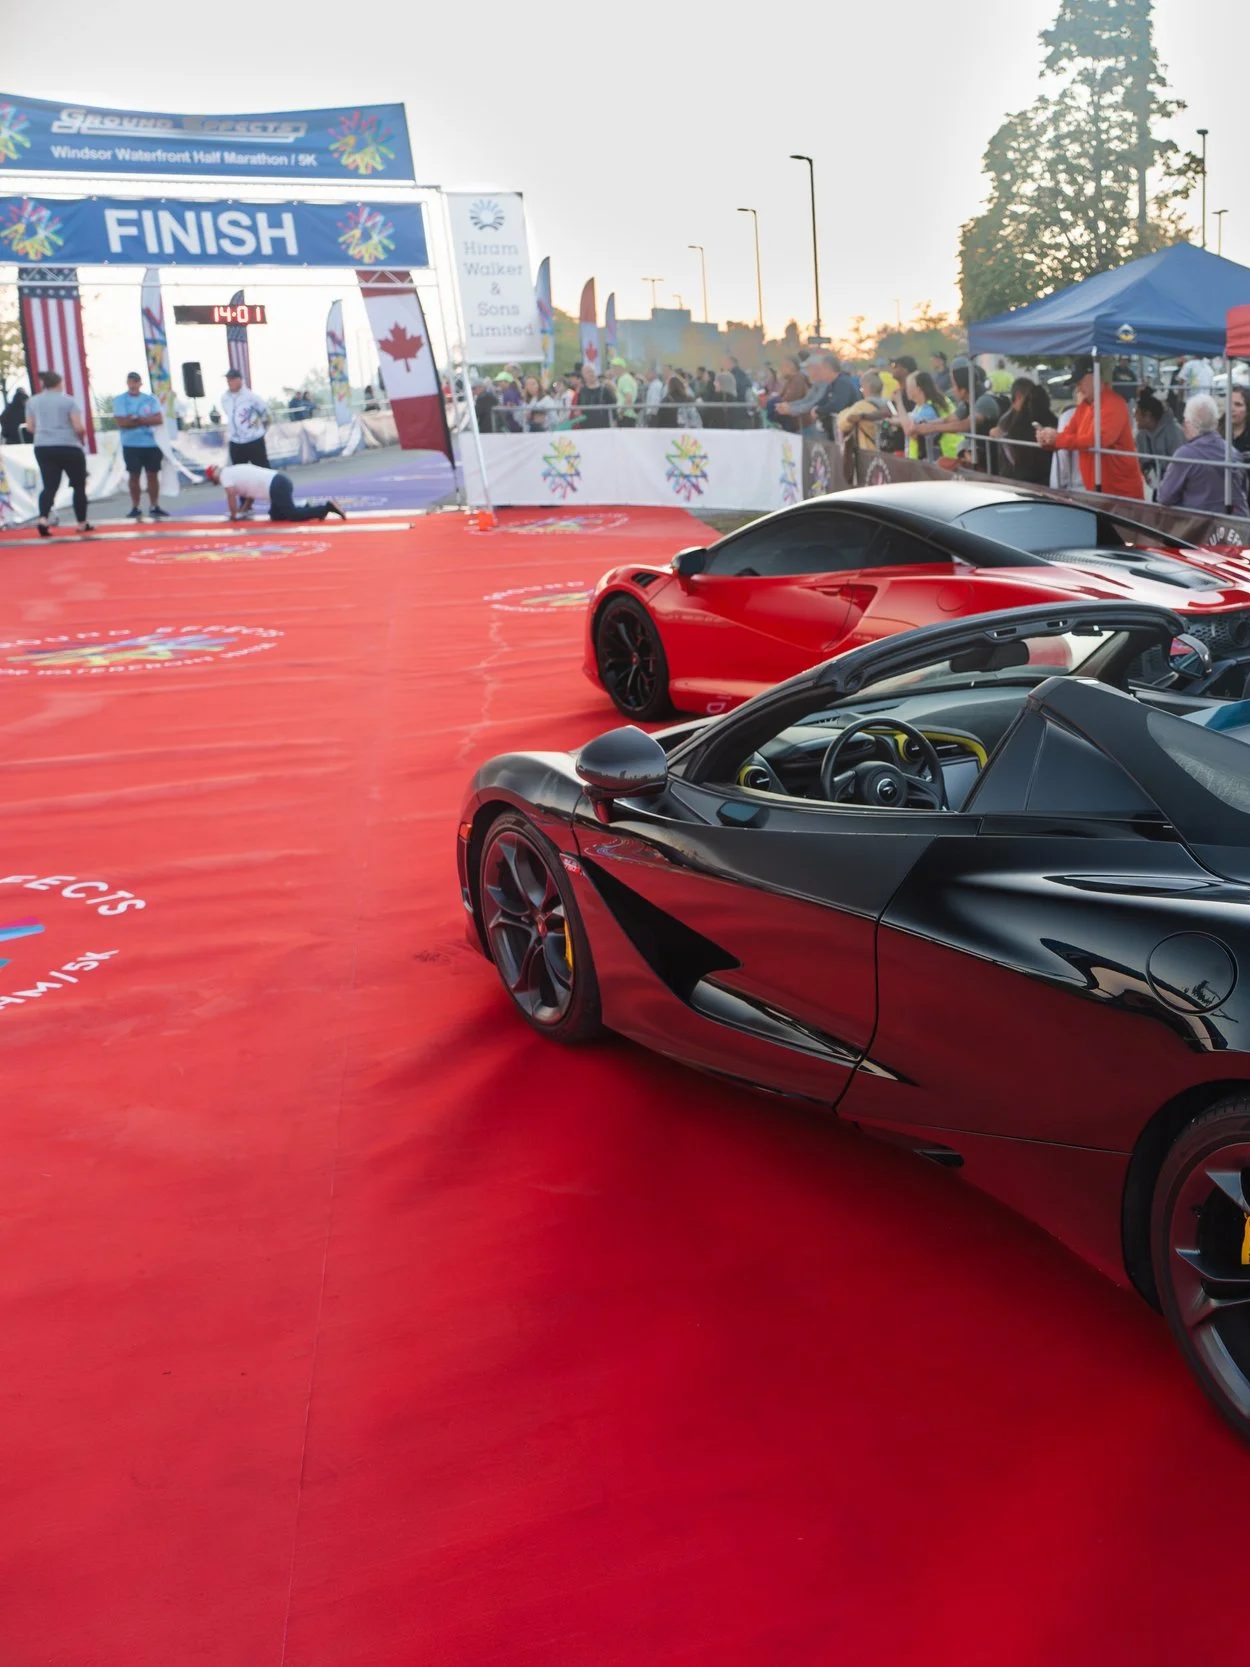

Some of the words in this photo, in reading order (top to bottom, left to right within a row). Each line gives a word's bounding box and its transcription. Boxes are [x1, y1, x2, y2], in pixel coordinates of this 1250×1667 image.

[51, 145, 112, 161] Windsor
[115, 147, 191, 163] Waterfront
[194, 150, 223, 163] Half
[224, 151, 289, 166] Marathon
[298, 153, 318, 166] 5K
[104, 208, 299, 256] FINISH
[463, 241, 519, 256] Hiram
[463, 261, 523, 276] Walker
[490, 281, 501, 296] &
[477, 300, 520, 316] Sons
[469, 323, 535, 338] Limited
[0, 875, 146, 916] FECTS
